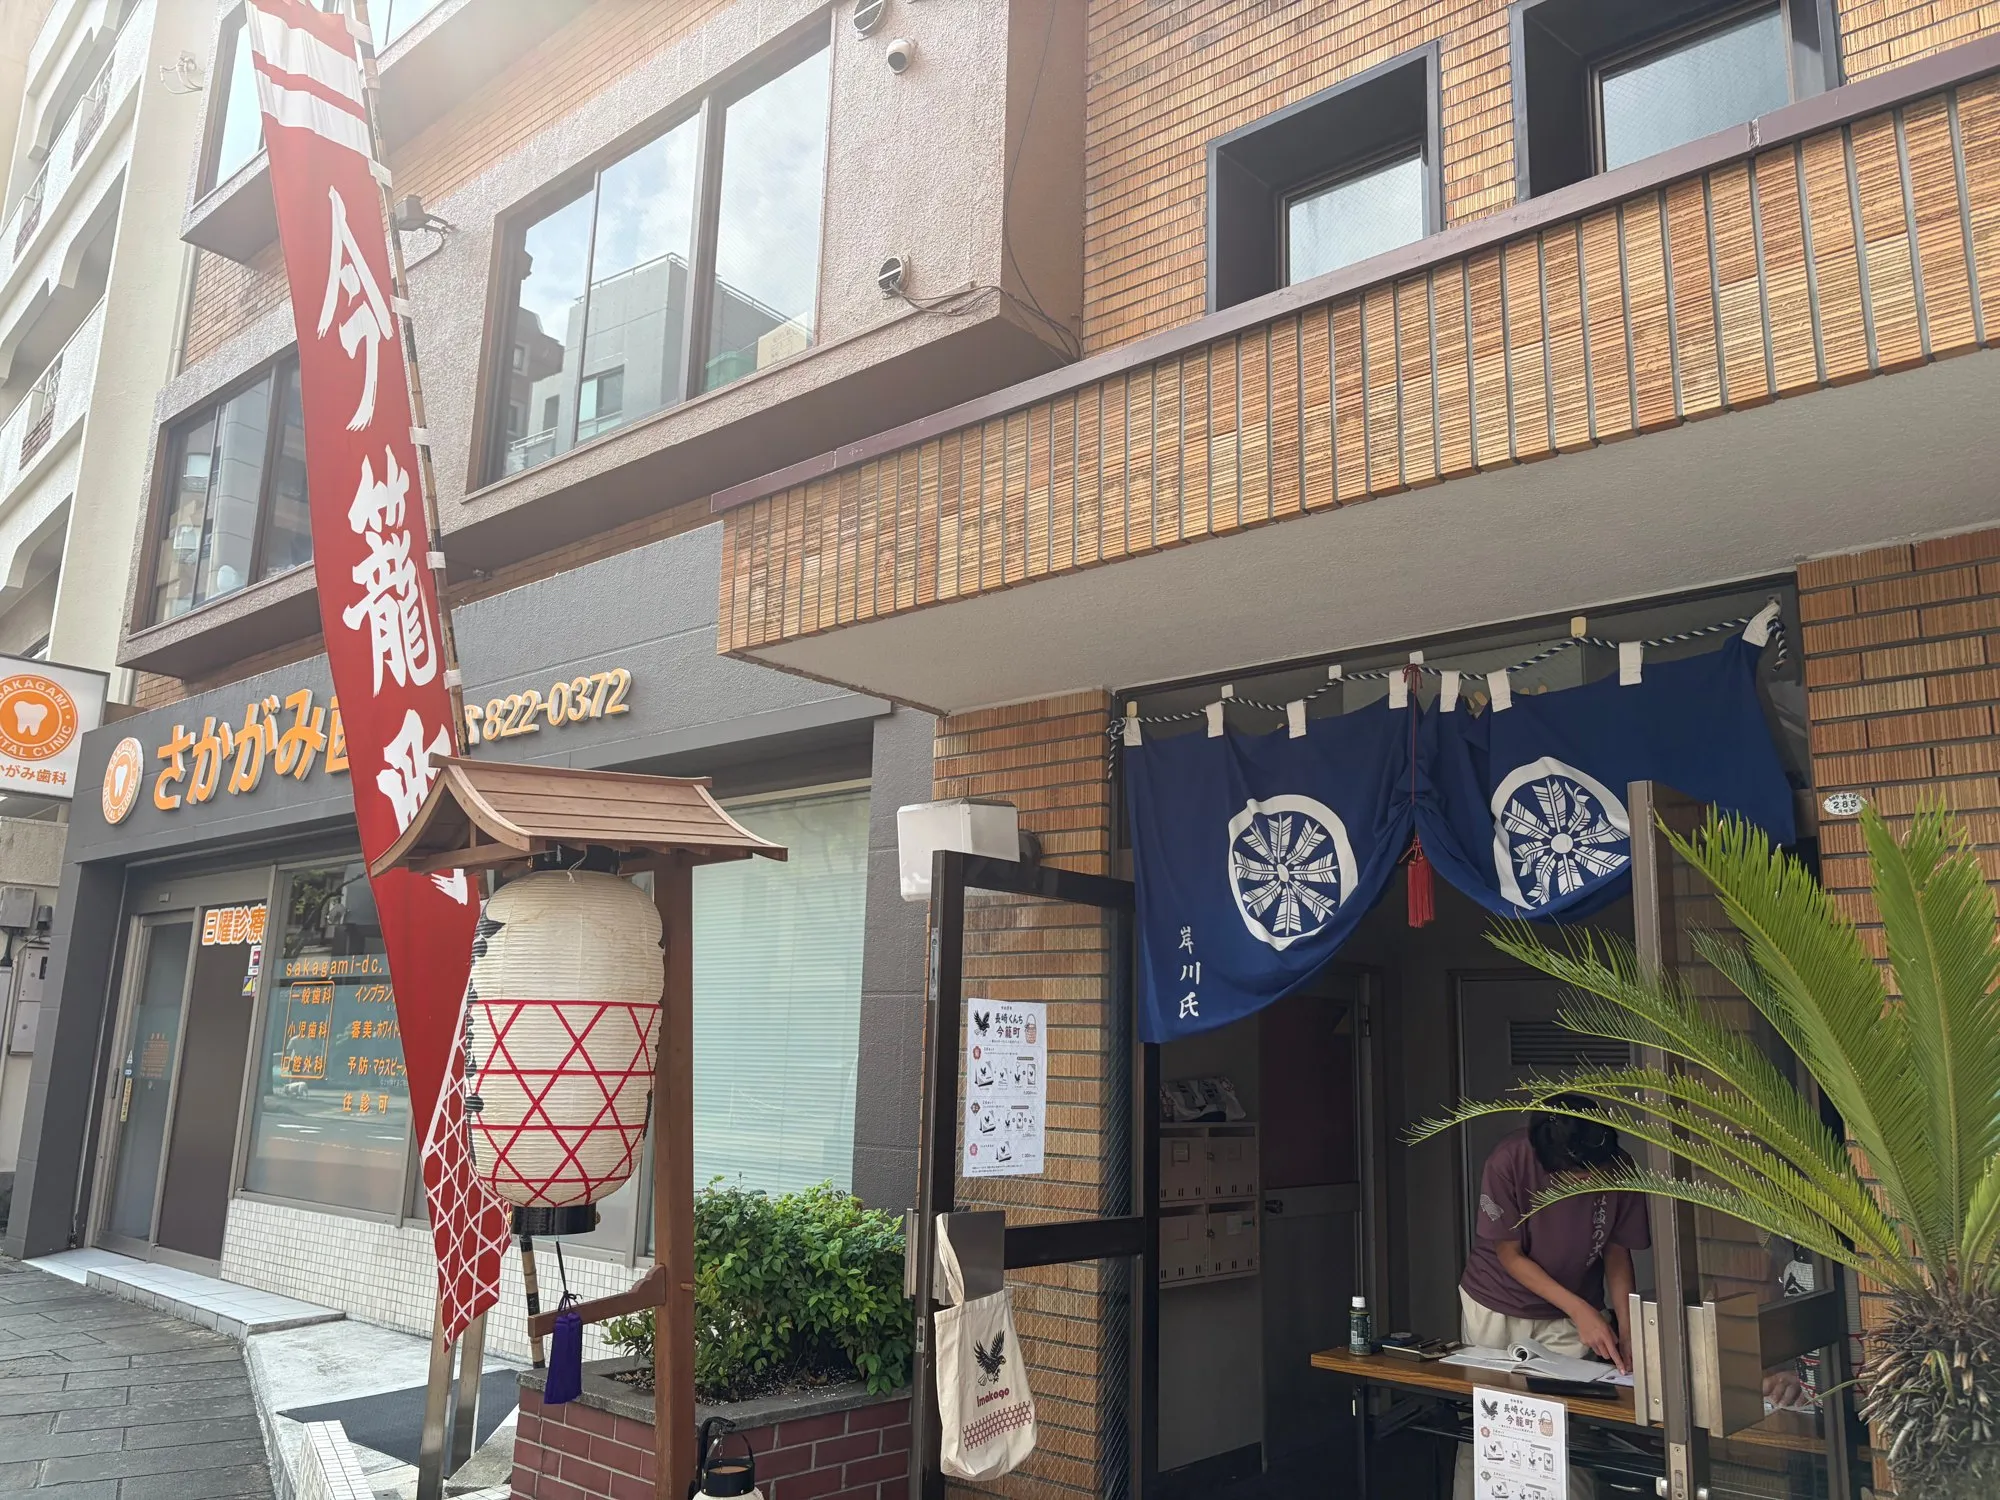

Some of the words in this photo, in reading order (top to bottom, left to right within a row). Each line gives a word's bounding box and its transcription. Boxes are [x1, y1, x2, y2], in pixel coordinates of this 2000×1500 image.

[483, 668, 632, 741] 822-0372
[32, 725, 72, 758] CLINIC
[203, 905, 267, 945] 日曜診療
[1179, 926, 1201, 1019] 岸川氏
[292, 986, 332, 1004] 一般歯科
[287, 1019, 328, 1039] 小児歯科
[352, 1019, 401, 1039] 審美・ホワイト
[281, 1055, 325, 1074] 口腔外科
[342, 1092, 389, 1115] 往診可
